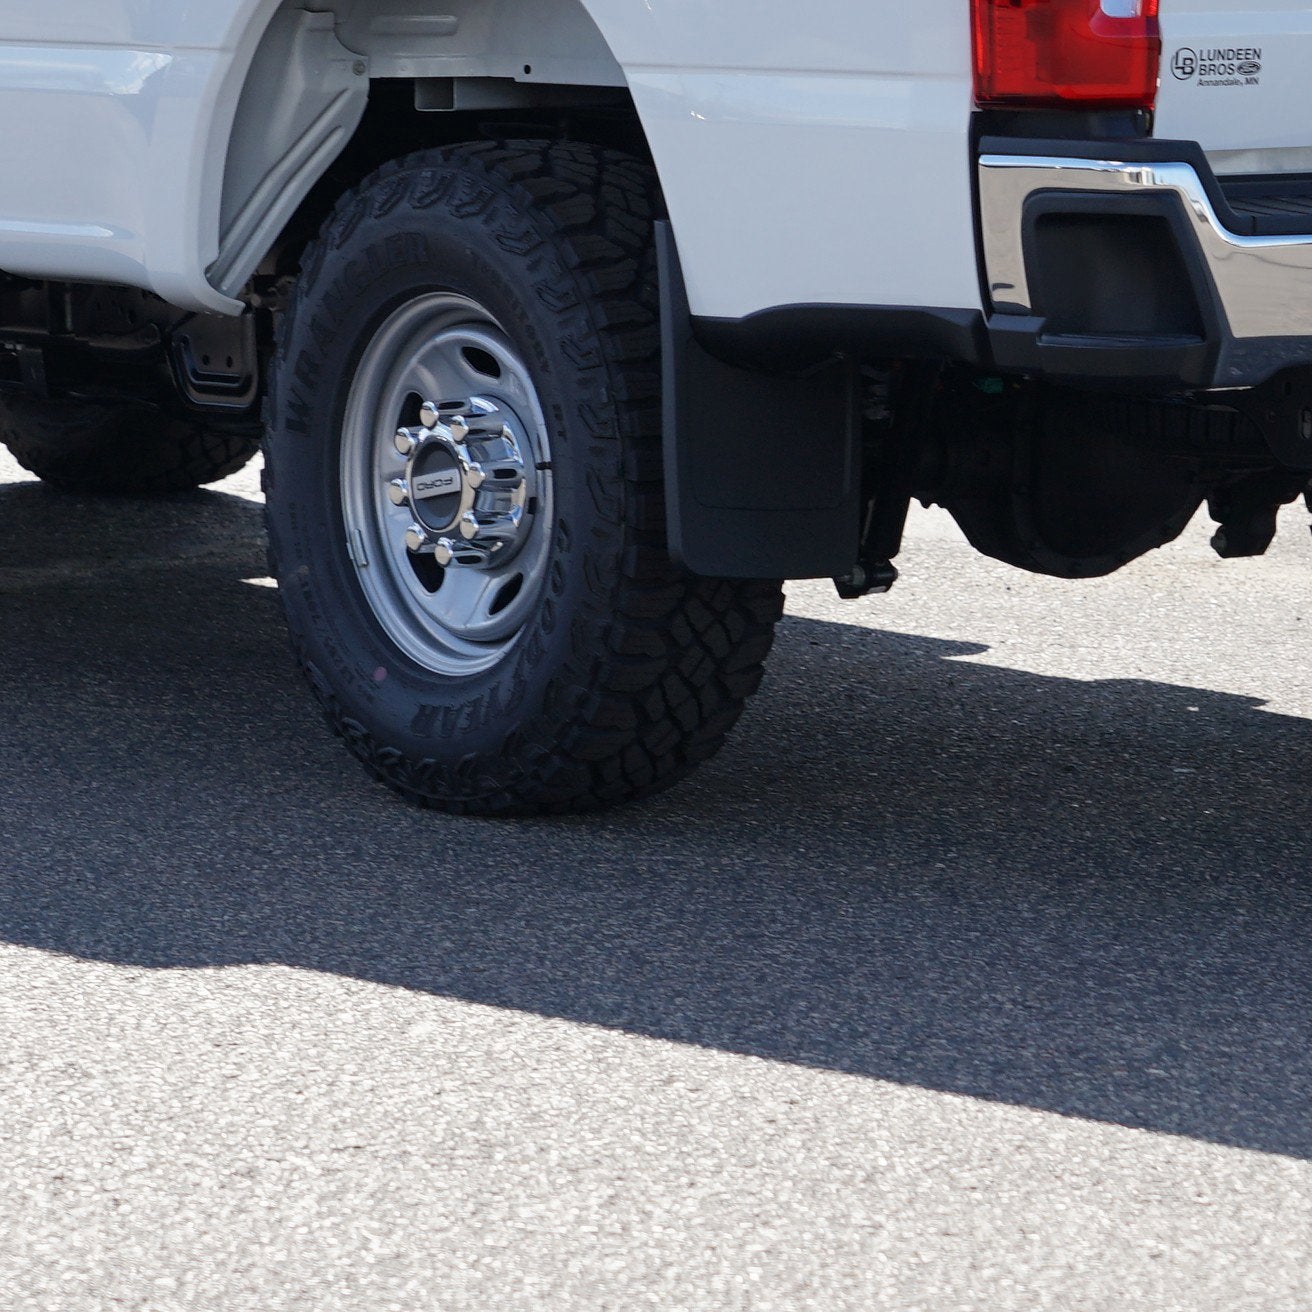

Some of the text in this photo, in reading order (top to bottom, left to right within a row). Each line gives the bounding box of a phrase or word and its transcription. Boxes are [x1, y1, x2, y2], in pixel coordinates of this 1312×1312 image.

[1199, 48, 1262, 62] LUNDEEN
[1199, 63, 1235, 76] BROS
[285, 231, 431, 437] WRANGLER
[416, 476, 454, 492] FORD
